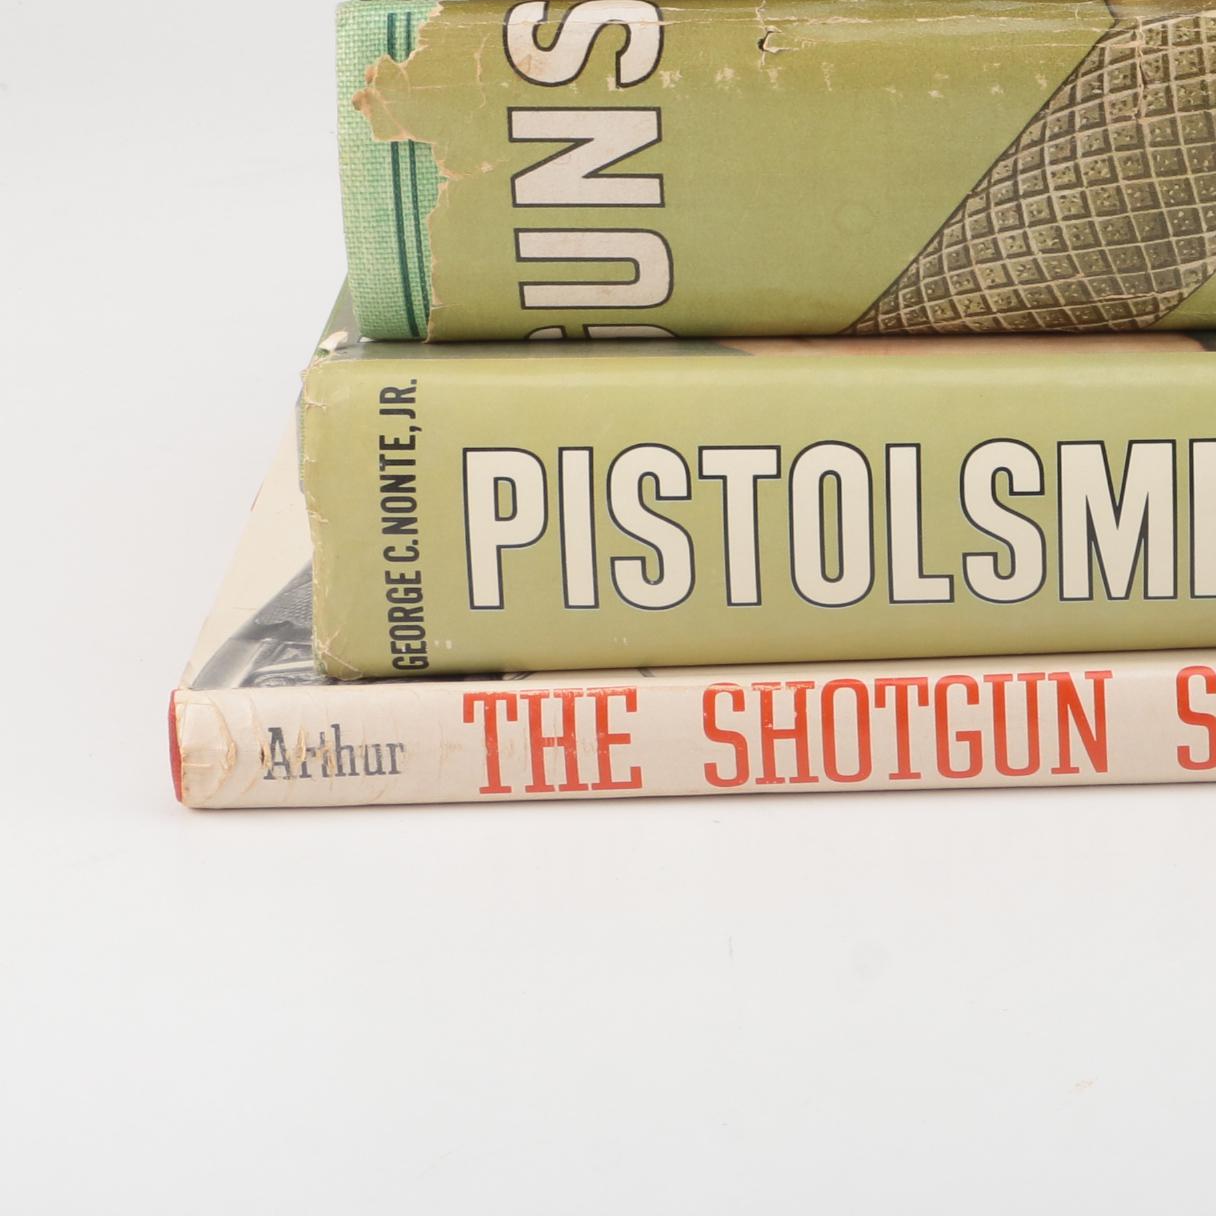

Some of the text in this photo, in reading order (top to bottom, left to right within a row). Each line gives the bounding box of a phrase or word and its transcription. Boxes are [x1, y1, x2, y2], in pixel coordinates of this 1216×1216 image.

[379, 378, 430, 671] GEORGE C. NONTE, JR.
[262, 724, 405, 781] Arthur
[461, 687, 644, 795] THE
[702, 670, 1113, 788] SHOTGUN
